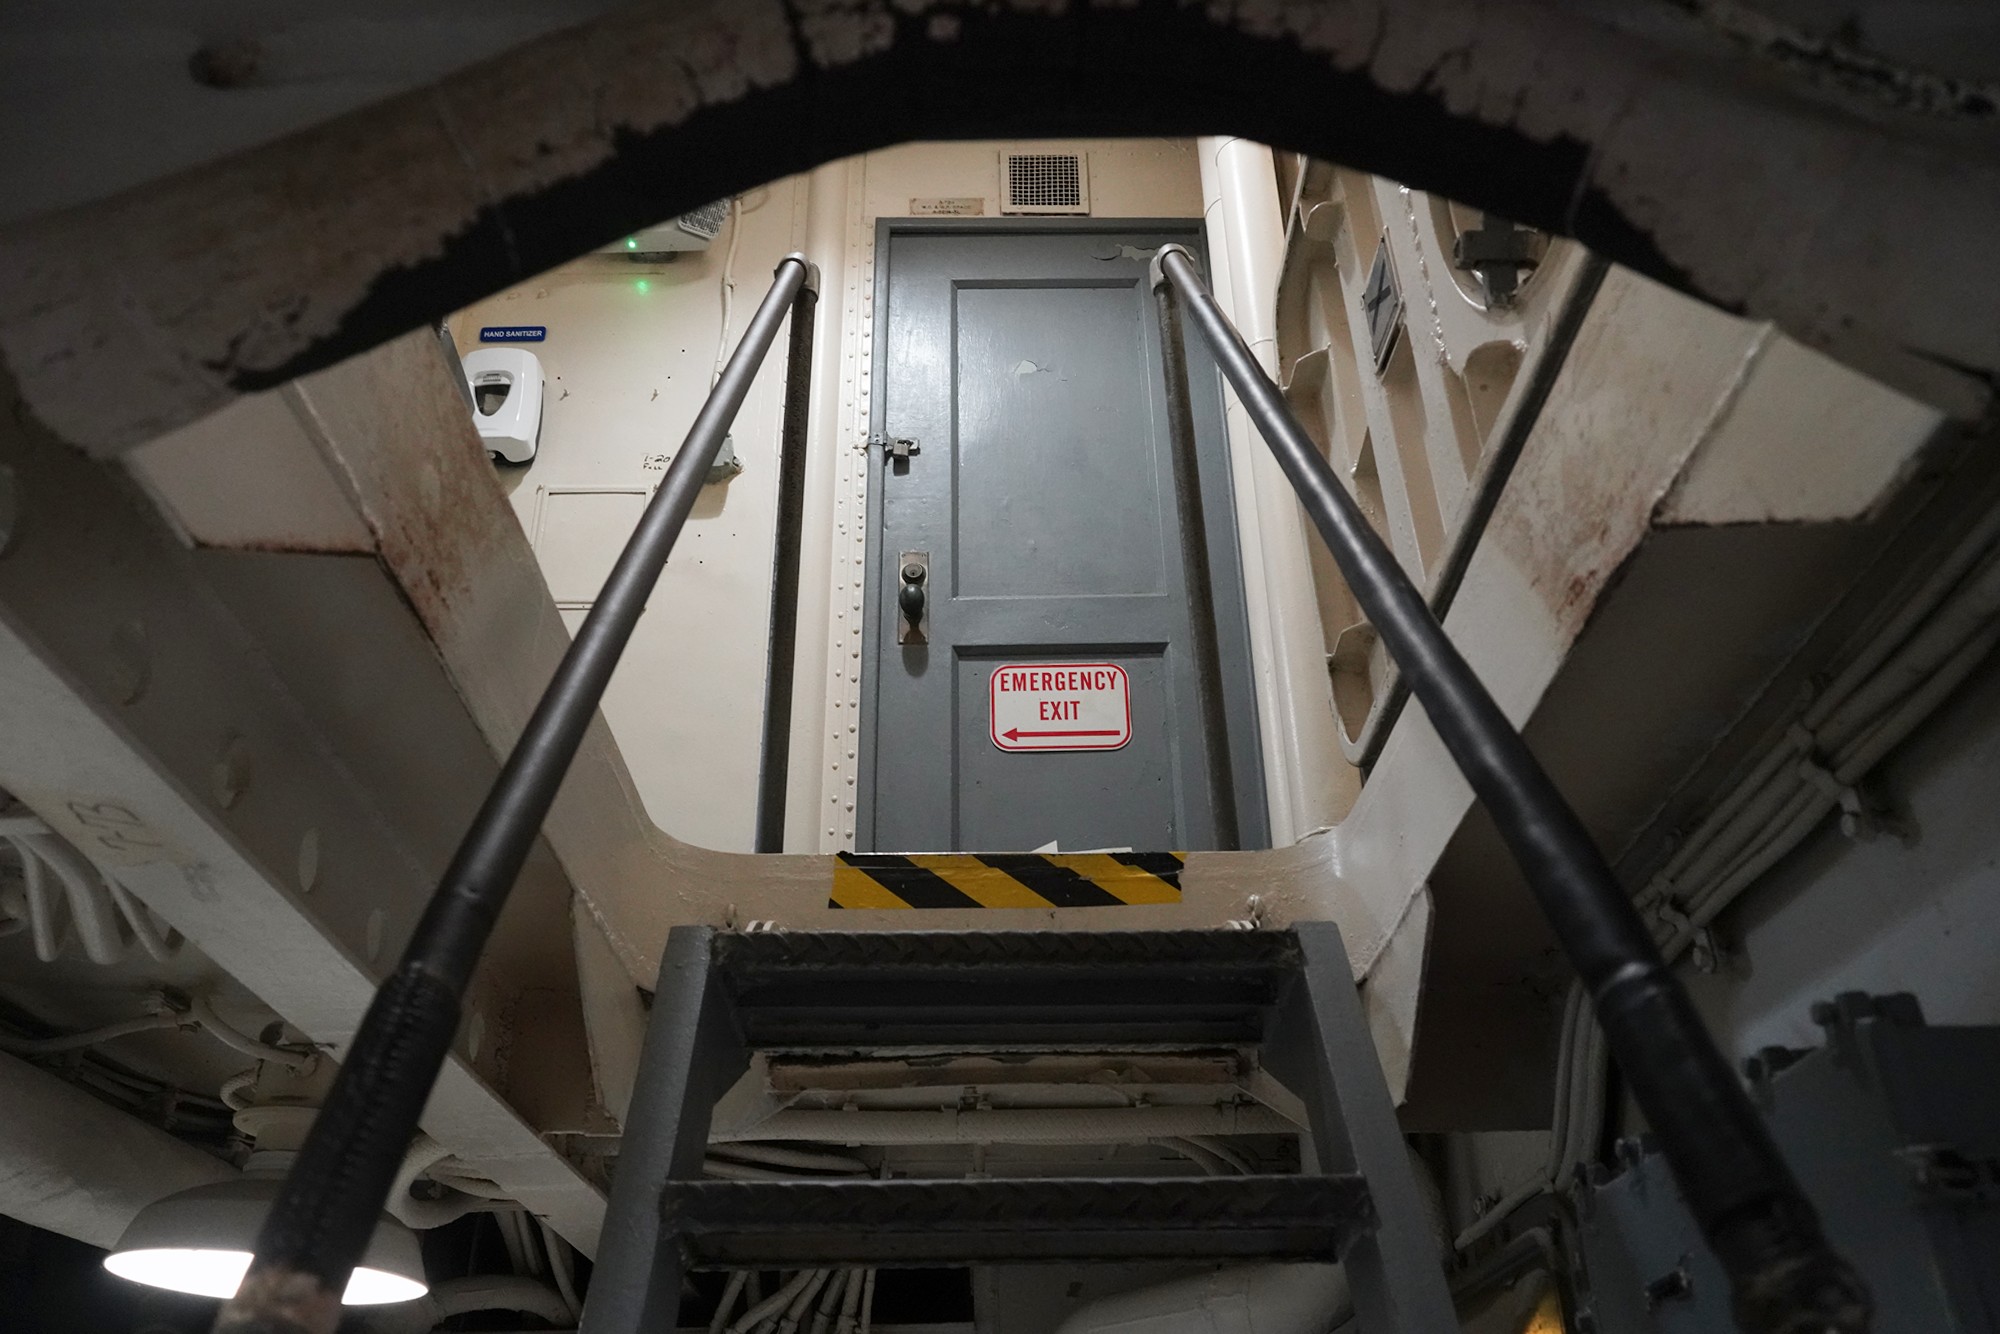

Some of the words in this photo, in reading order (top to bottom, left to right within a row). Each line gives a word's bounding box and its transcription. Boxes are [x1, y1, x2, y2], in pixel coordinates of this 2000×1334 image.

[505, 330, 543, 338] SANITIZER
[1000, 671, 1118, 692] EMERGENCY
[1040, 701, 1080, 721] EXIT
